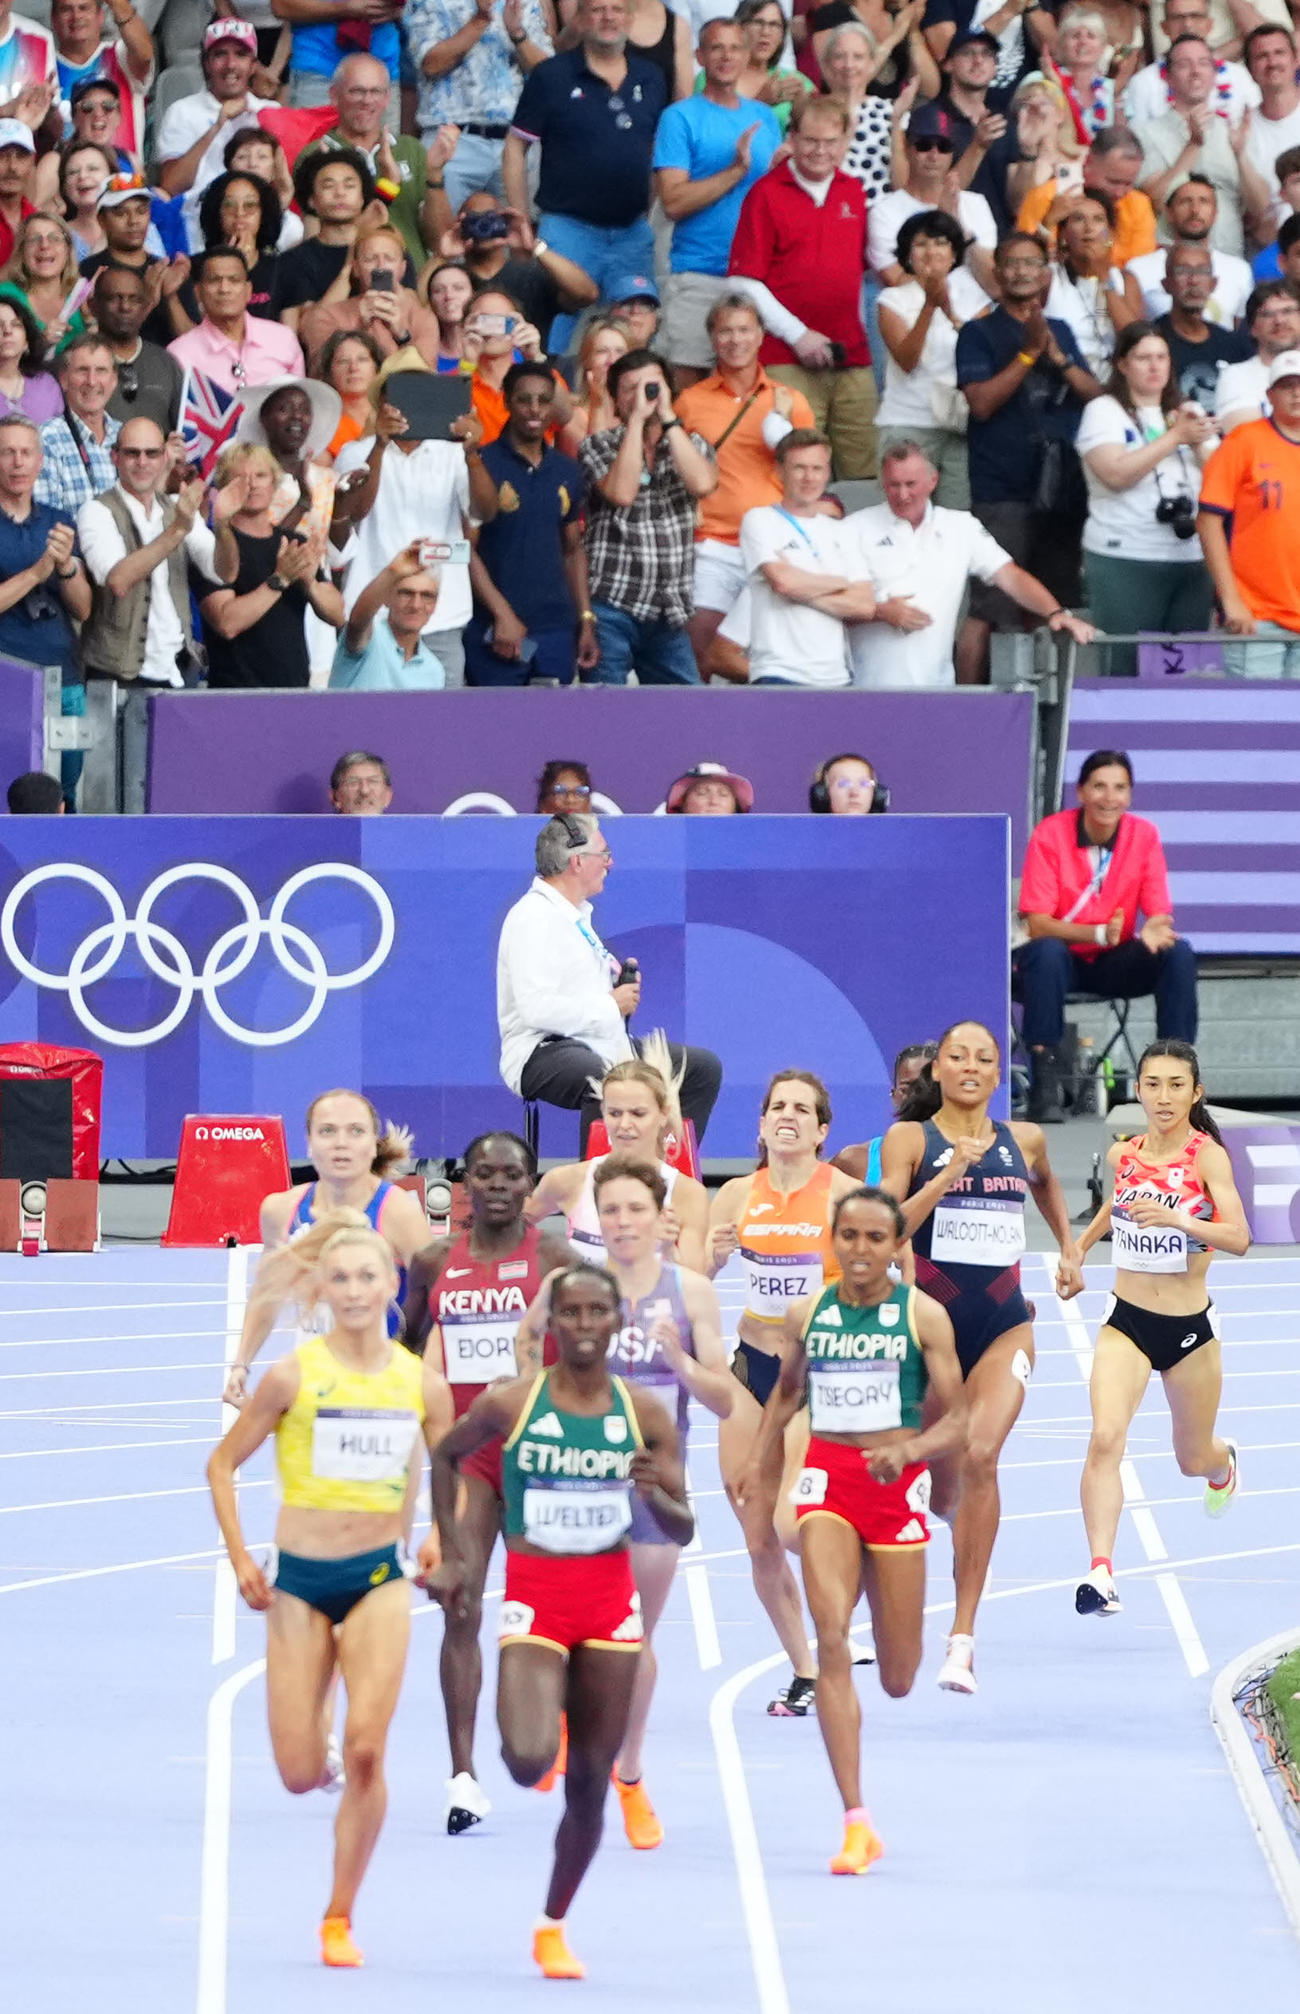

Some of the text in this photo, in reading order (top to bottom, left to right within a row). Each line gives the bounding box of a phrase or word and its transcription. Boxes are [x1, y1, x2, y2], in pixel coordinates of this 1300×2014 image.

[211, 1127, 264, 1140] OMEGA
[742, 1222, 823, 1237] ESPAÑA
[1115, 1227, 1182, 1254] TANAKA
[750, 1273, 808, 1296] PEREZ
[439, 1286, 528, 1316] KENYA
[458, 1336, 517, 1358] EJOR
[806, 1331, 908, 1361] ETHIOPIA
[817, 1382, 892, 1407] TSEGAY
[340, 1434, 392, 1455] HULL
